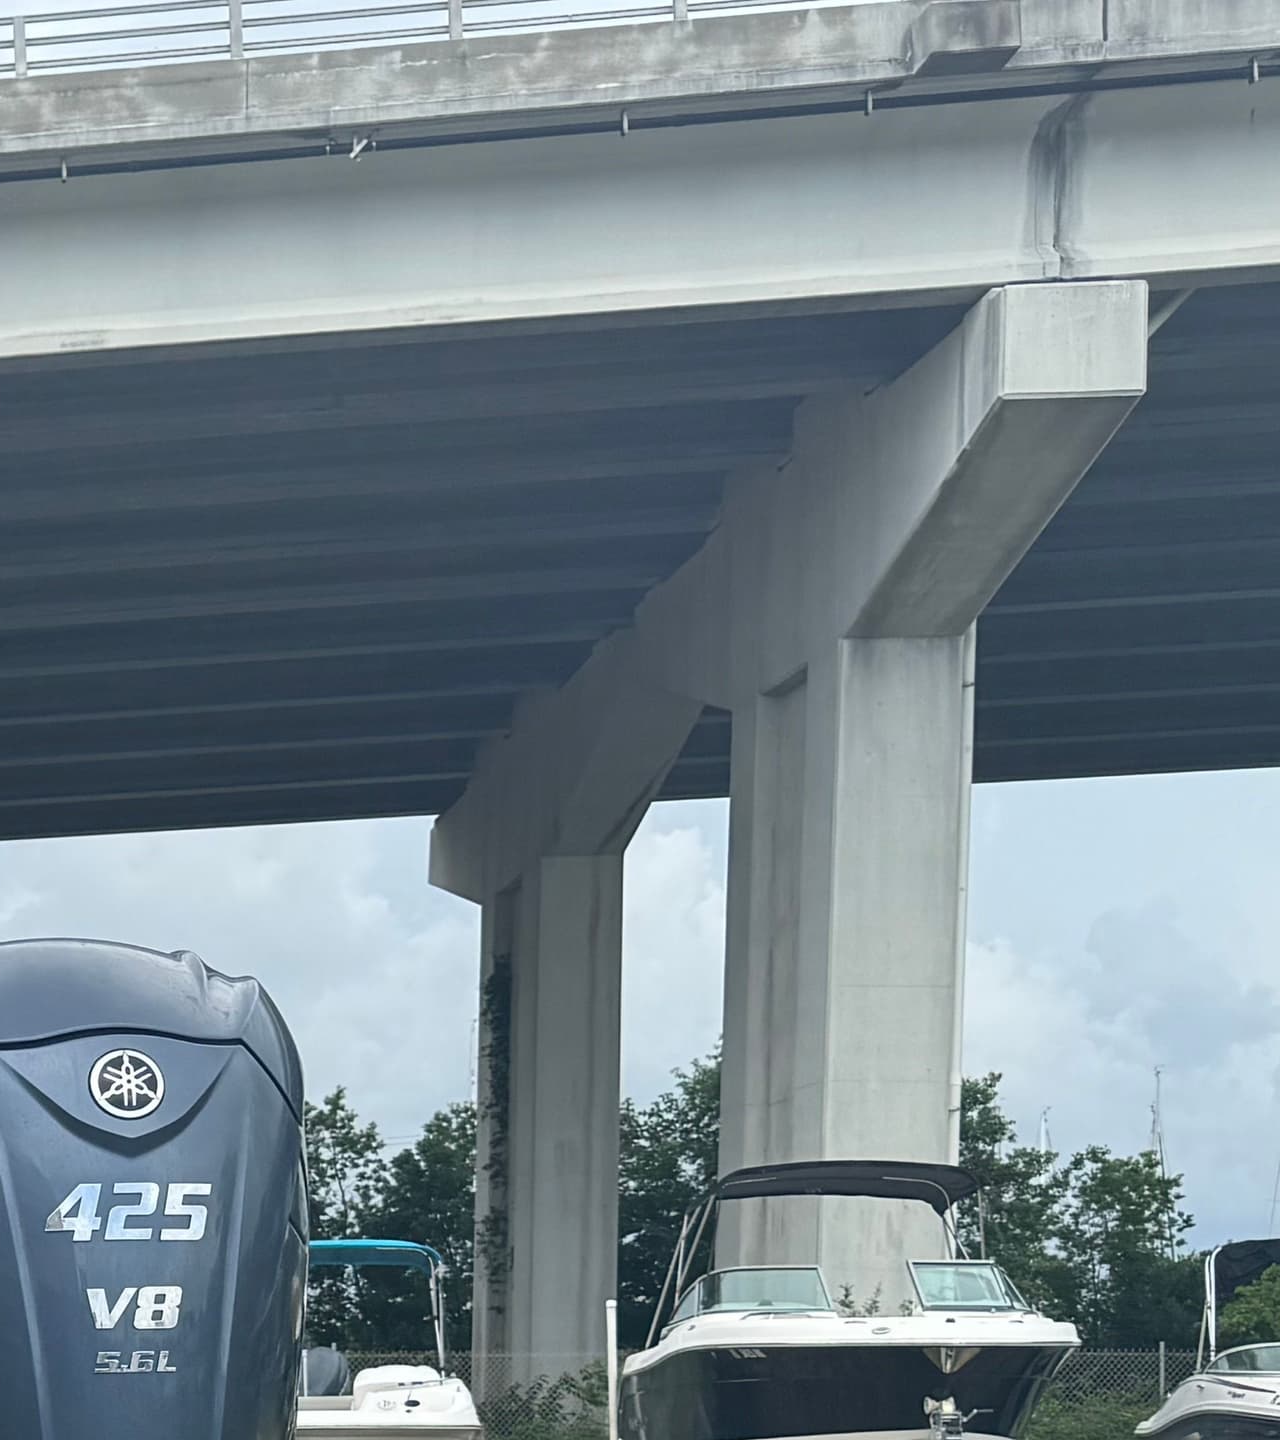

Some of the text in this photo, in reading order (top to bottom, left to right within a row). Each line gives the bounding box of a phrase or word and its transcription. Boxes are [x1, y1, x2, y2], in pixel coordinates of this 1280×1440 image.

[44, 1182, 213, 1242] 425
[86, 1285, 183, 1330] V8
[94, 1350, 177, 1373] 5.6L
